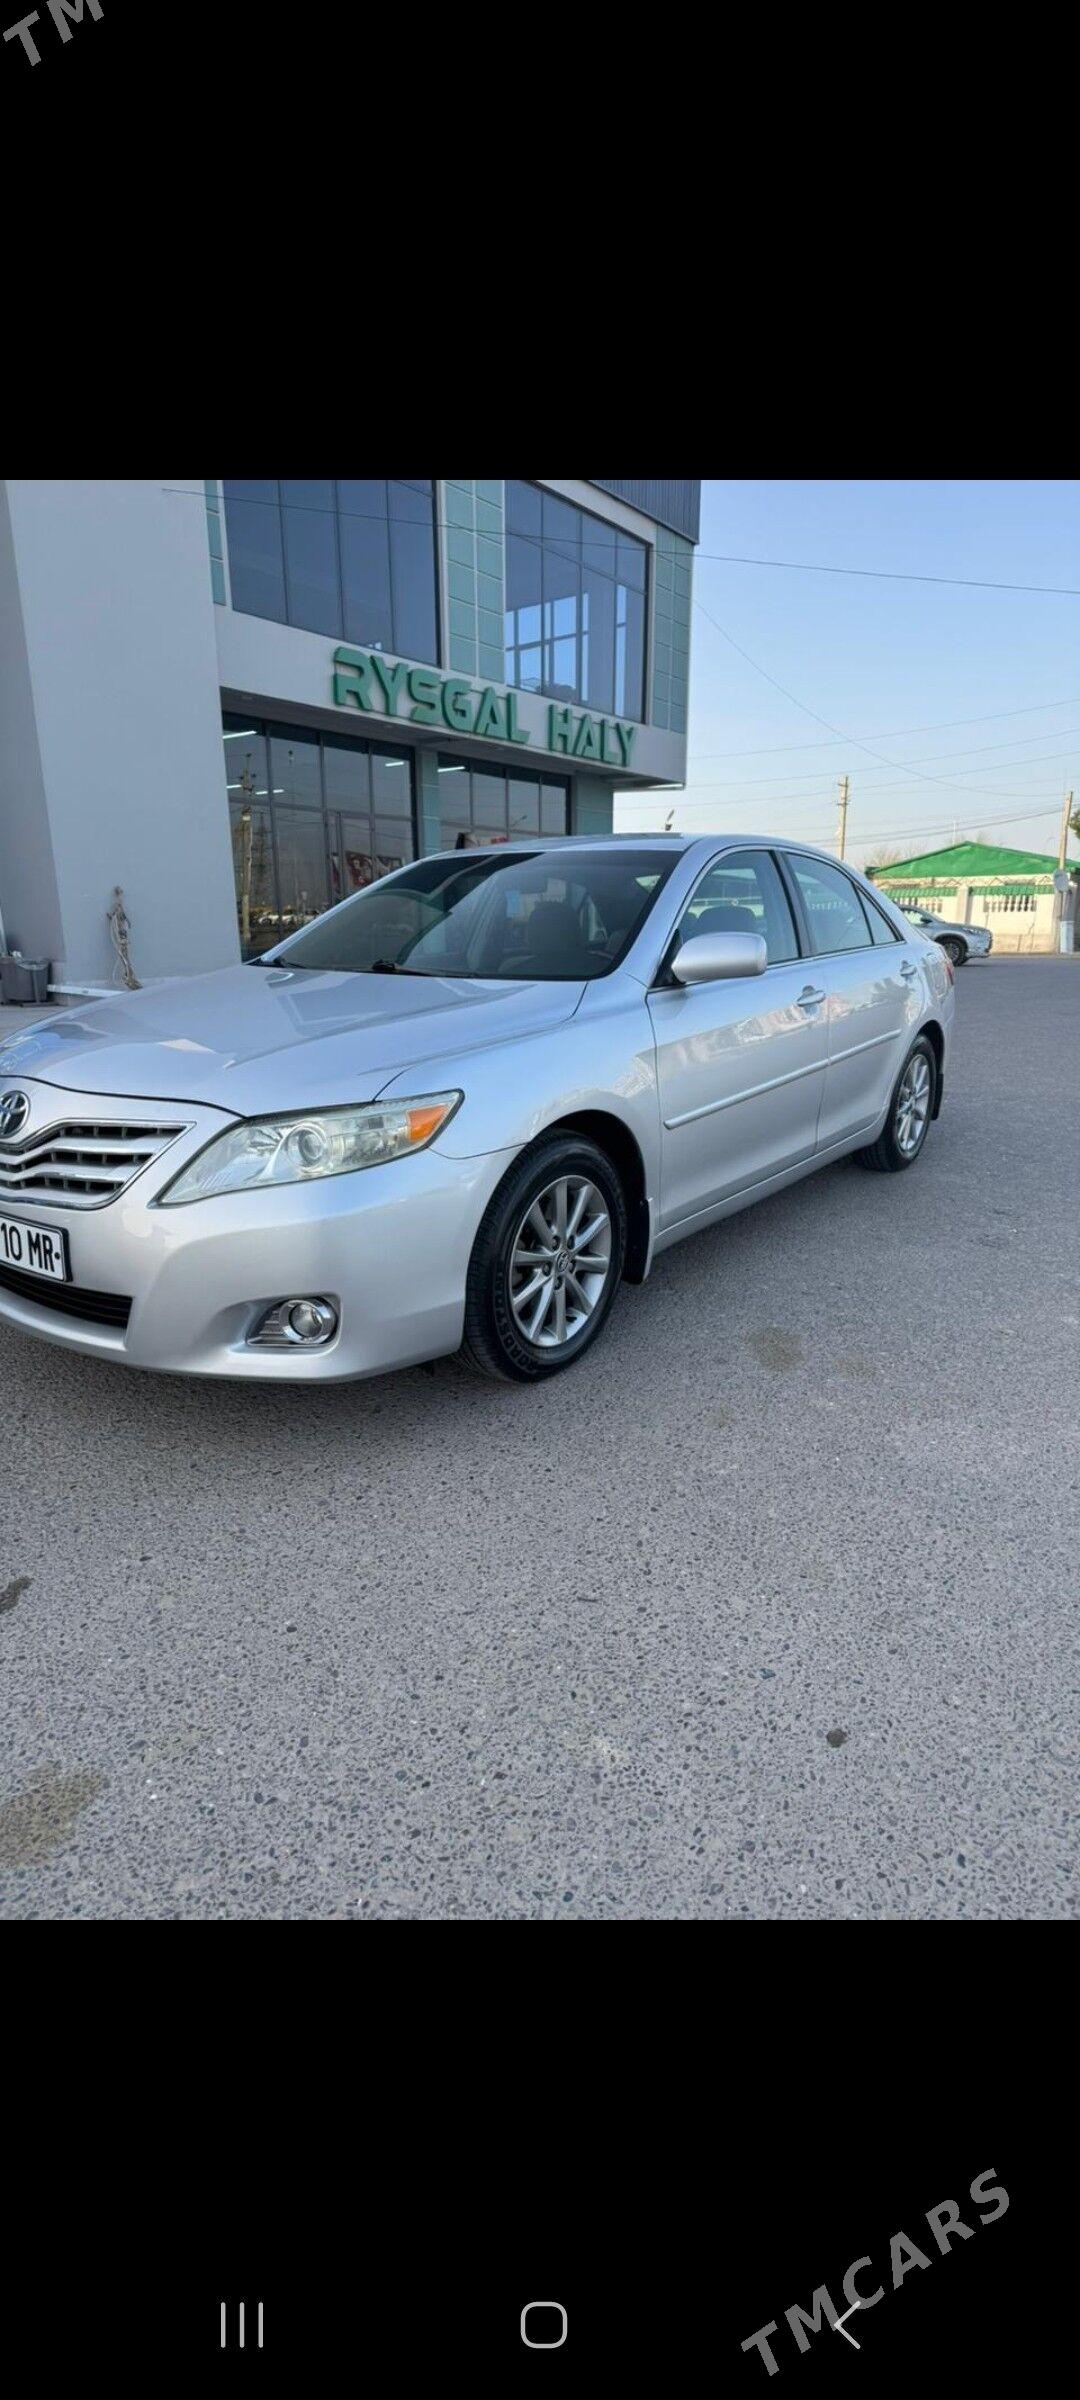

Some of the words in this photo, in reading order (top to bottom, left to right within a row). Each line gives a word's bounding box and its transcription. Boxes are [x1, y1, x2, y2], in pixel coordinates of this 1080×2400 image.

[333, 647, 530, 744] RYSGAL
[548, 703, 634, 767] HALY
[27, 1229, 55, 1272] MR
